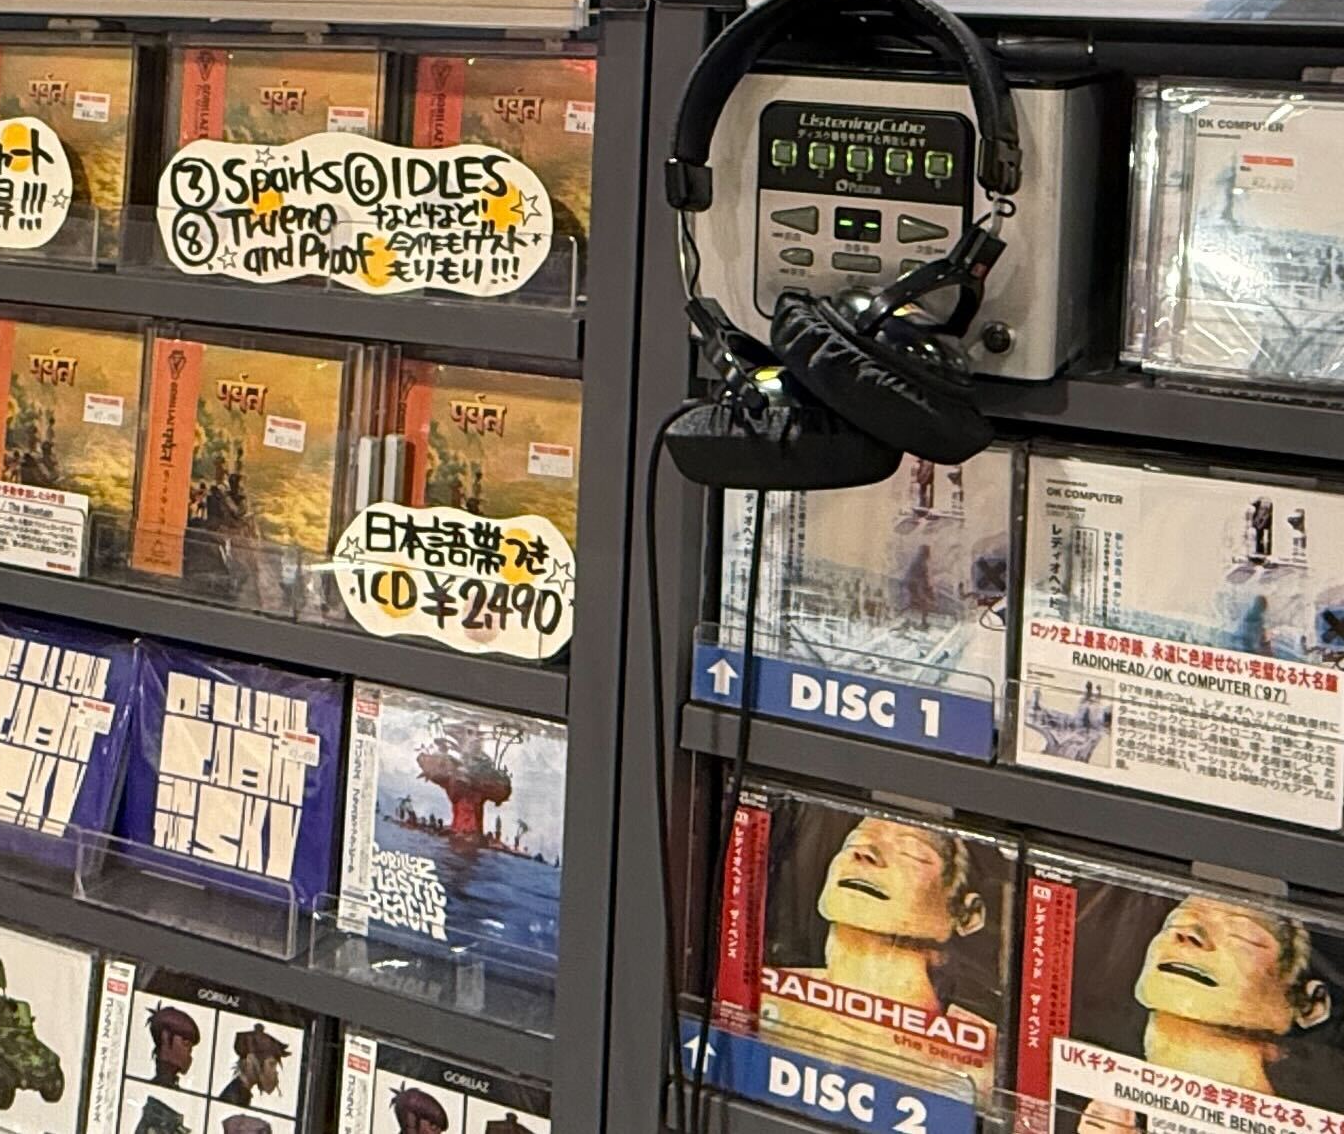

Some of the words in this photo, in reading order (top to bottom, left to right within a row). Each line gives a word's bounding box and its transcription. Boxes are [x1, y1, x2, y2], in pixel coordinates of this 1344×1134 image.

[221, 150, 346, 204] Sparks
[391, 156, 511, 200] IDLES
[243, 234, 296, 275] and
[299, 232, 378, 277] Proof
[1064, 487, 1124, 505] COMPUTER
[365, 510, 550, 575] 日本語帯つき
[790, 672, 896, 729] DISC
[920, 698, 940, 739] 1
[1177, 670, 1252, 697] COMPUTER
[760, 968, 988, 1053] RADIOHEAD
[768, 1055, 877, 1124] DISC
[891, 1096, 929, 1134] 2
